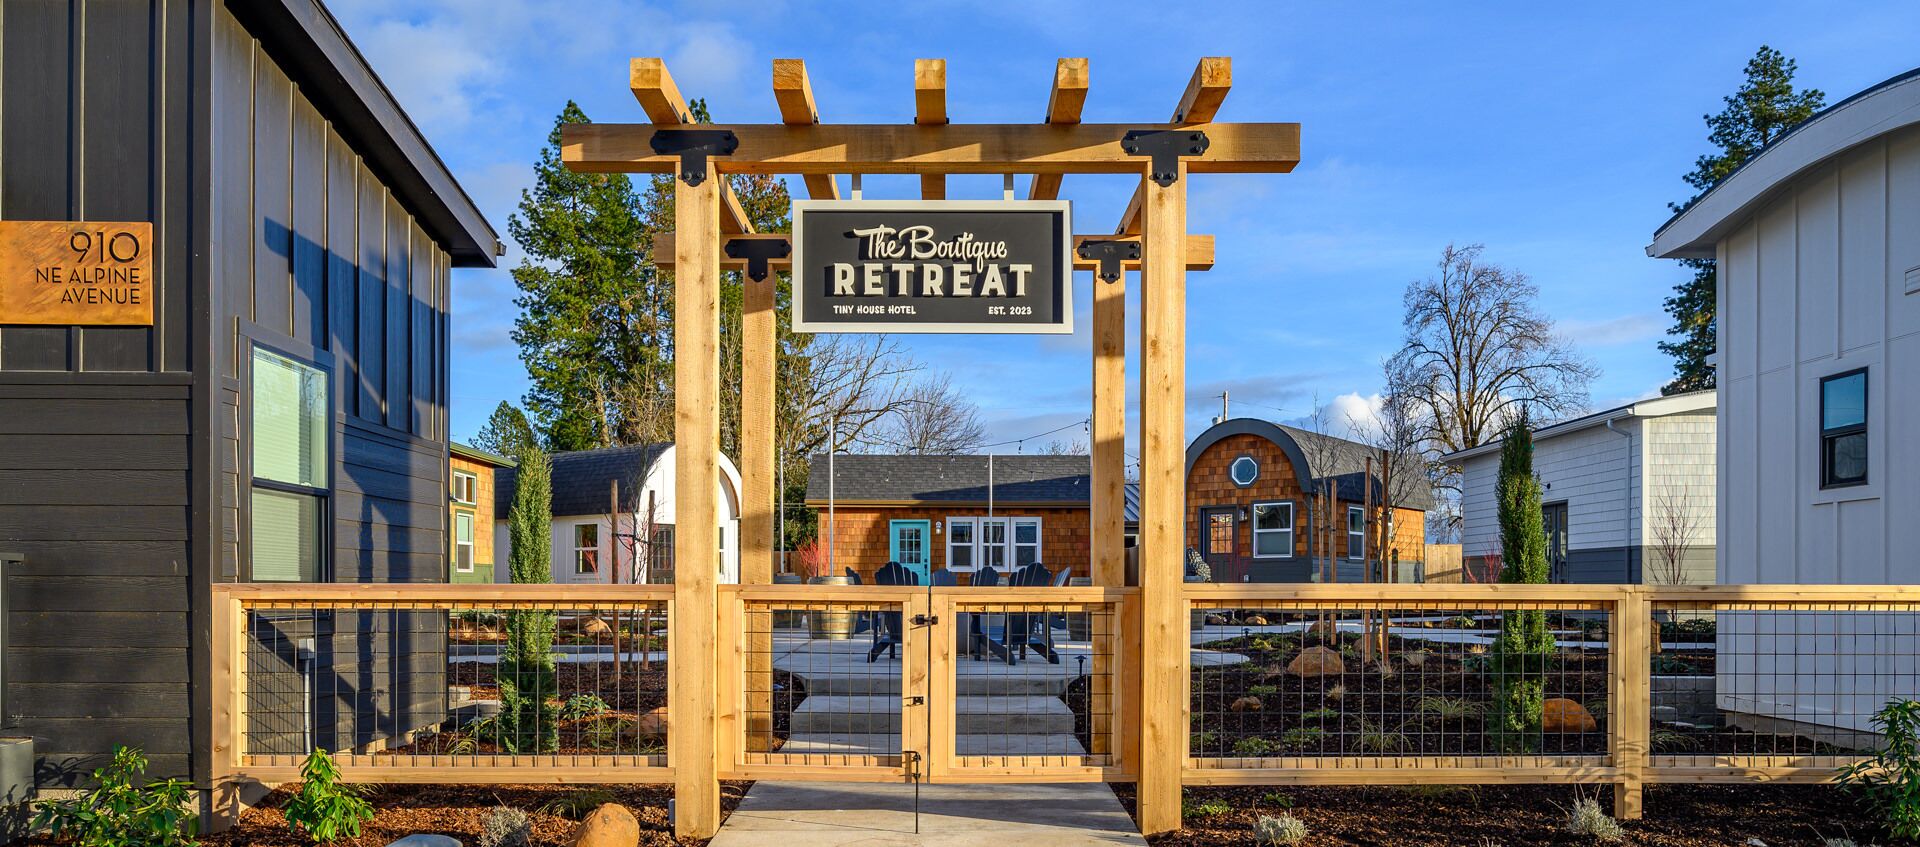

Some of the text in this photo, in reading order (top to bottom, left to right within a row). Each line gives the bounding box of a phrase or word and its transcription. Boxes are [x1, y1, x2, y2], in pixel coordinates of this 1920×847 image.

[70, 231, 140, 264] 910
[853, 224, 1007, 273] The Boutique
[36, 267, 140, 284] NE ALPINE
[833, 262, 1033, 297] RETREAT
[61, 287, 140, 305] AVENUE
[833, 305, 917, 316] TINY HOUSE HOTEL
[988, 306, 1033, 316] EST. 2023
